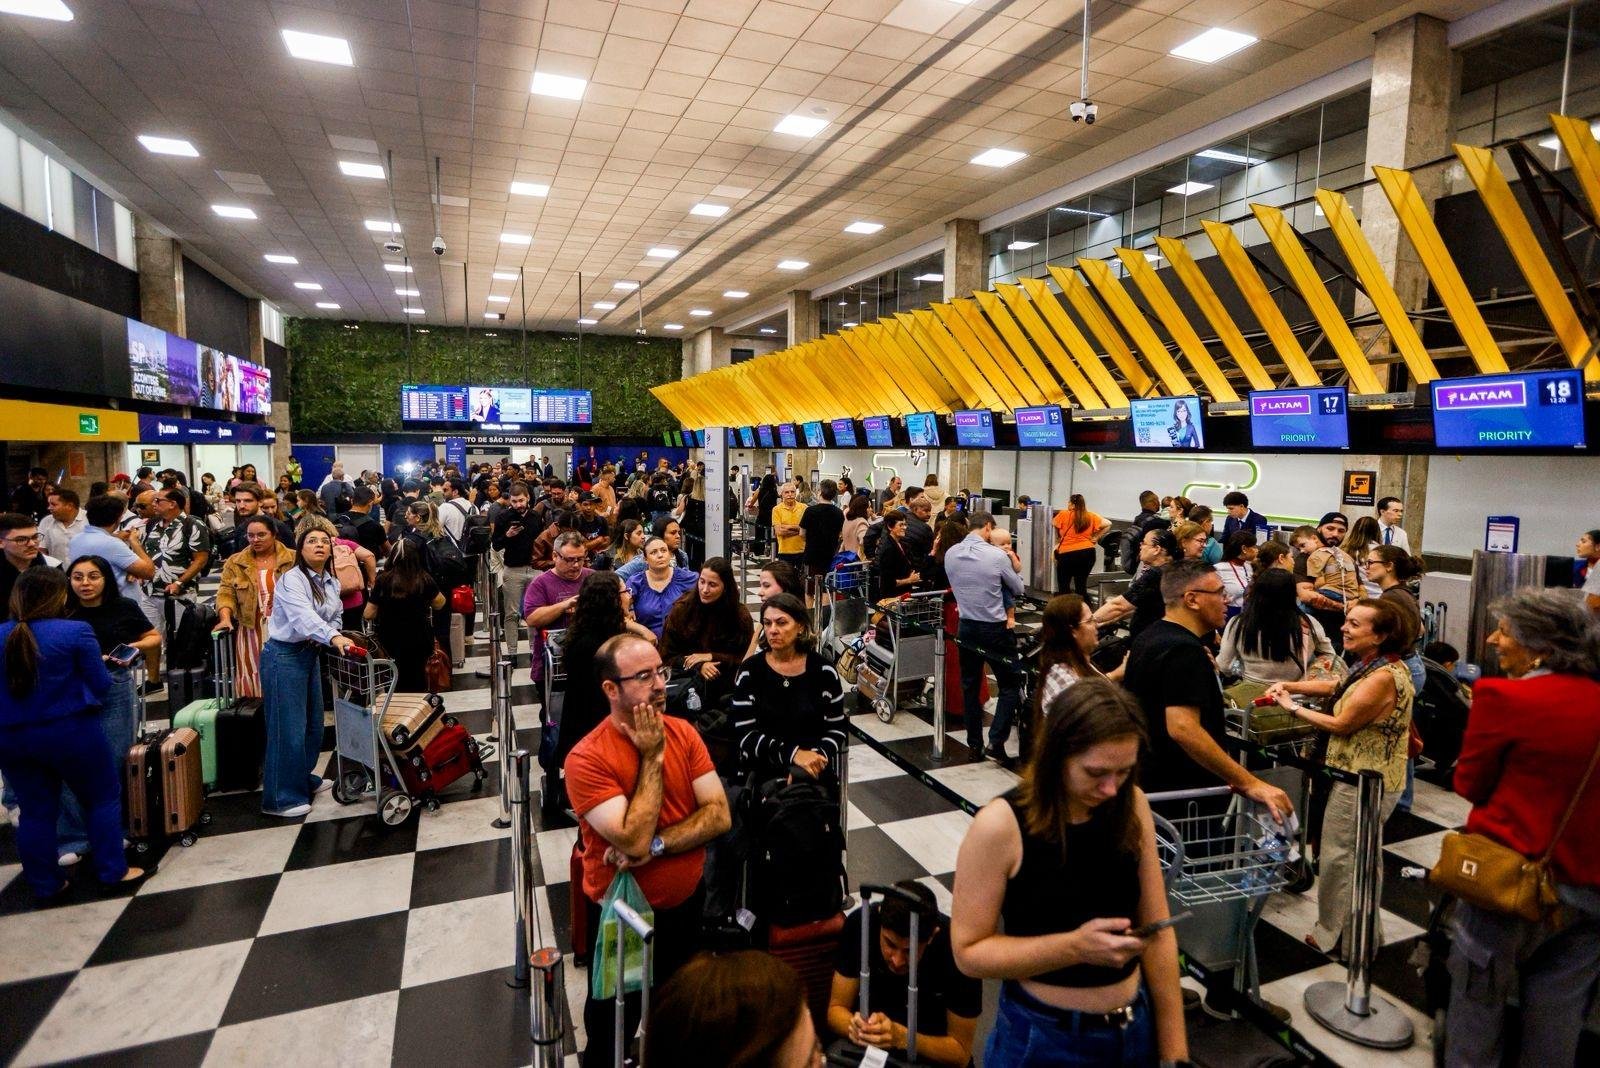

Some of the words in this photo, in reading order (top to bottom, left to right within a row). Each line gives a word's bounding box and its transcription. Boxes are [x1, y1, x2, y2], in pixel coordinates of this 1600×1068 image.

[1546, 380, 1572, 398] 18
[1460, 390, 1513, 402] LATAM
[1268, 401, 1303, 410] LATAM
[1323, 396, 1339, 409] 17
[1050, 412, 1059, 421] 15
[1280, 433, 1317, 442] PRIORITY
[1479, 430, 1533, 441] PRIORITY
